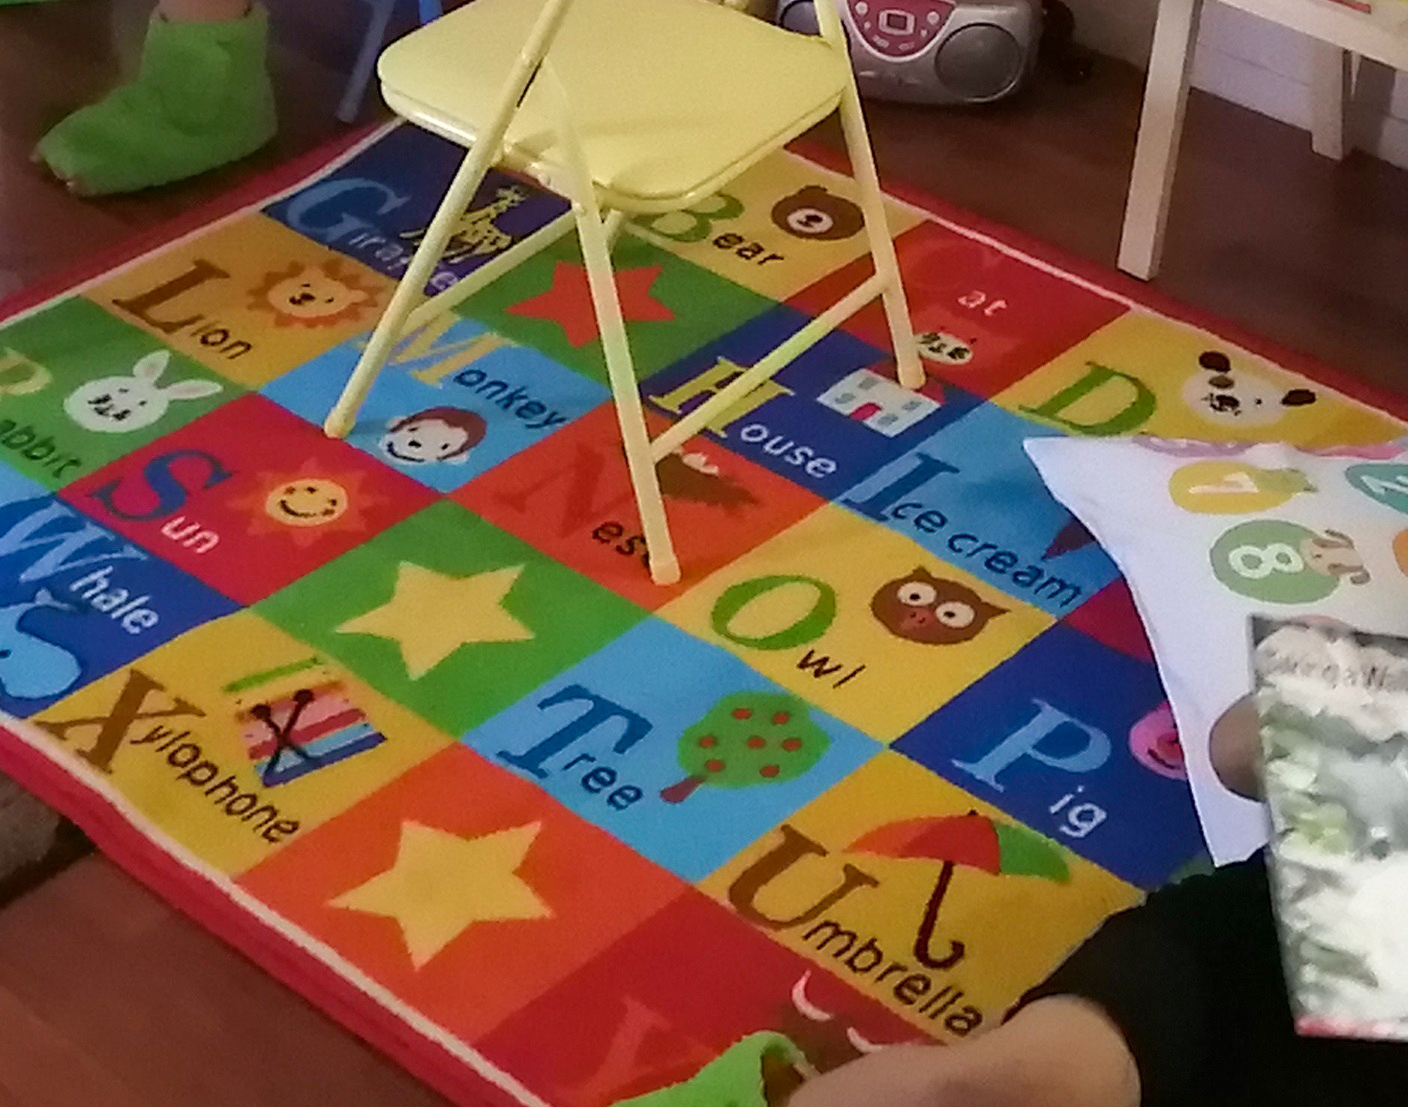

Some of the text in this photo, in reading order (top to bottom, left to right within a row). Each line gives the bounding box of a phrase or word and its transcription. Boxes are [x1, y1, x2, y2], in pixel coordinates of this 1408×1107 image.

[112, 259, 252, 360] Lion
[349, 311, 570, 431] Monkey
[649, 355, 840, 480] House
[95, 449, 237, 555] Sun
[840, 453, 1083, 608] Ice cream
[1228, 543, 1304, 579] 8
[711, 574, 867, 690] Owl
[34, 668, 300, 845] Xylophone
[499, 684, 654, 811] Tree
[951, 698, 1108, 839] Pig
[727, 824, 985, 1040] Umbrella
